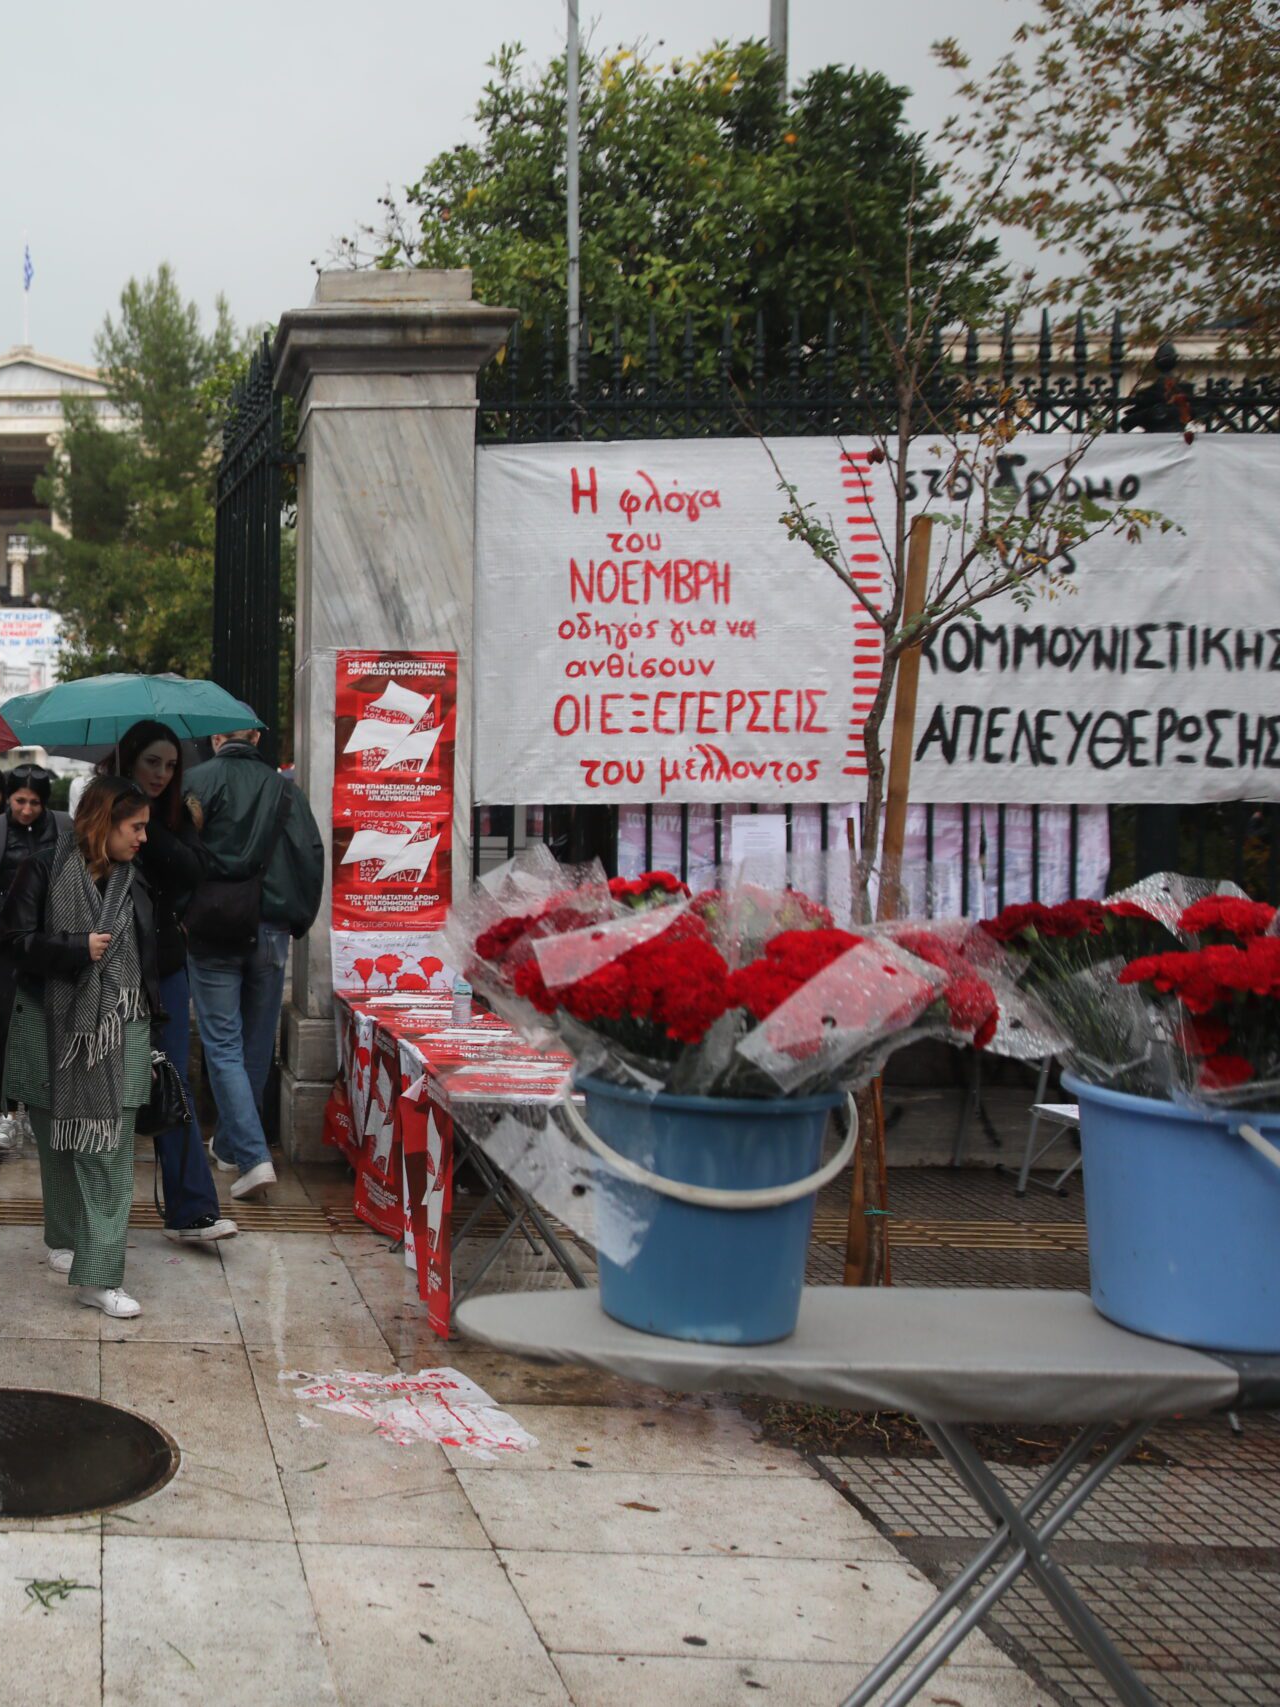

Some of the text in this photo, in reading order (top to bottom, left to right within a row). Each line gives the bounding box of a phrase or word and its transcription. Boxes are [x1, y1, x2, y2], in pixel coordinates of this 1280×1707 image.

[570, 466, 721, 525] Η φλόγα
[606, 532, 661, 553] του
[570, 557, 731, 605] ΝΟΕΜΒΡΗ
[558, 611, 757, 650] οδηγός για να
[565, 653, 715, 678] ανθίσουν
[553, 689, 828, 737] ΟΙ ΕΞΕΓΕΡΣΕΙΣ
[579, 744, 821, 795] του μέλλοντος
